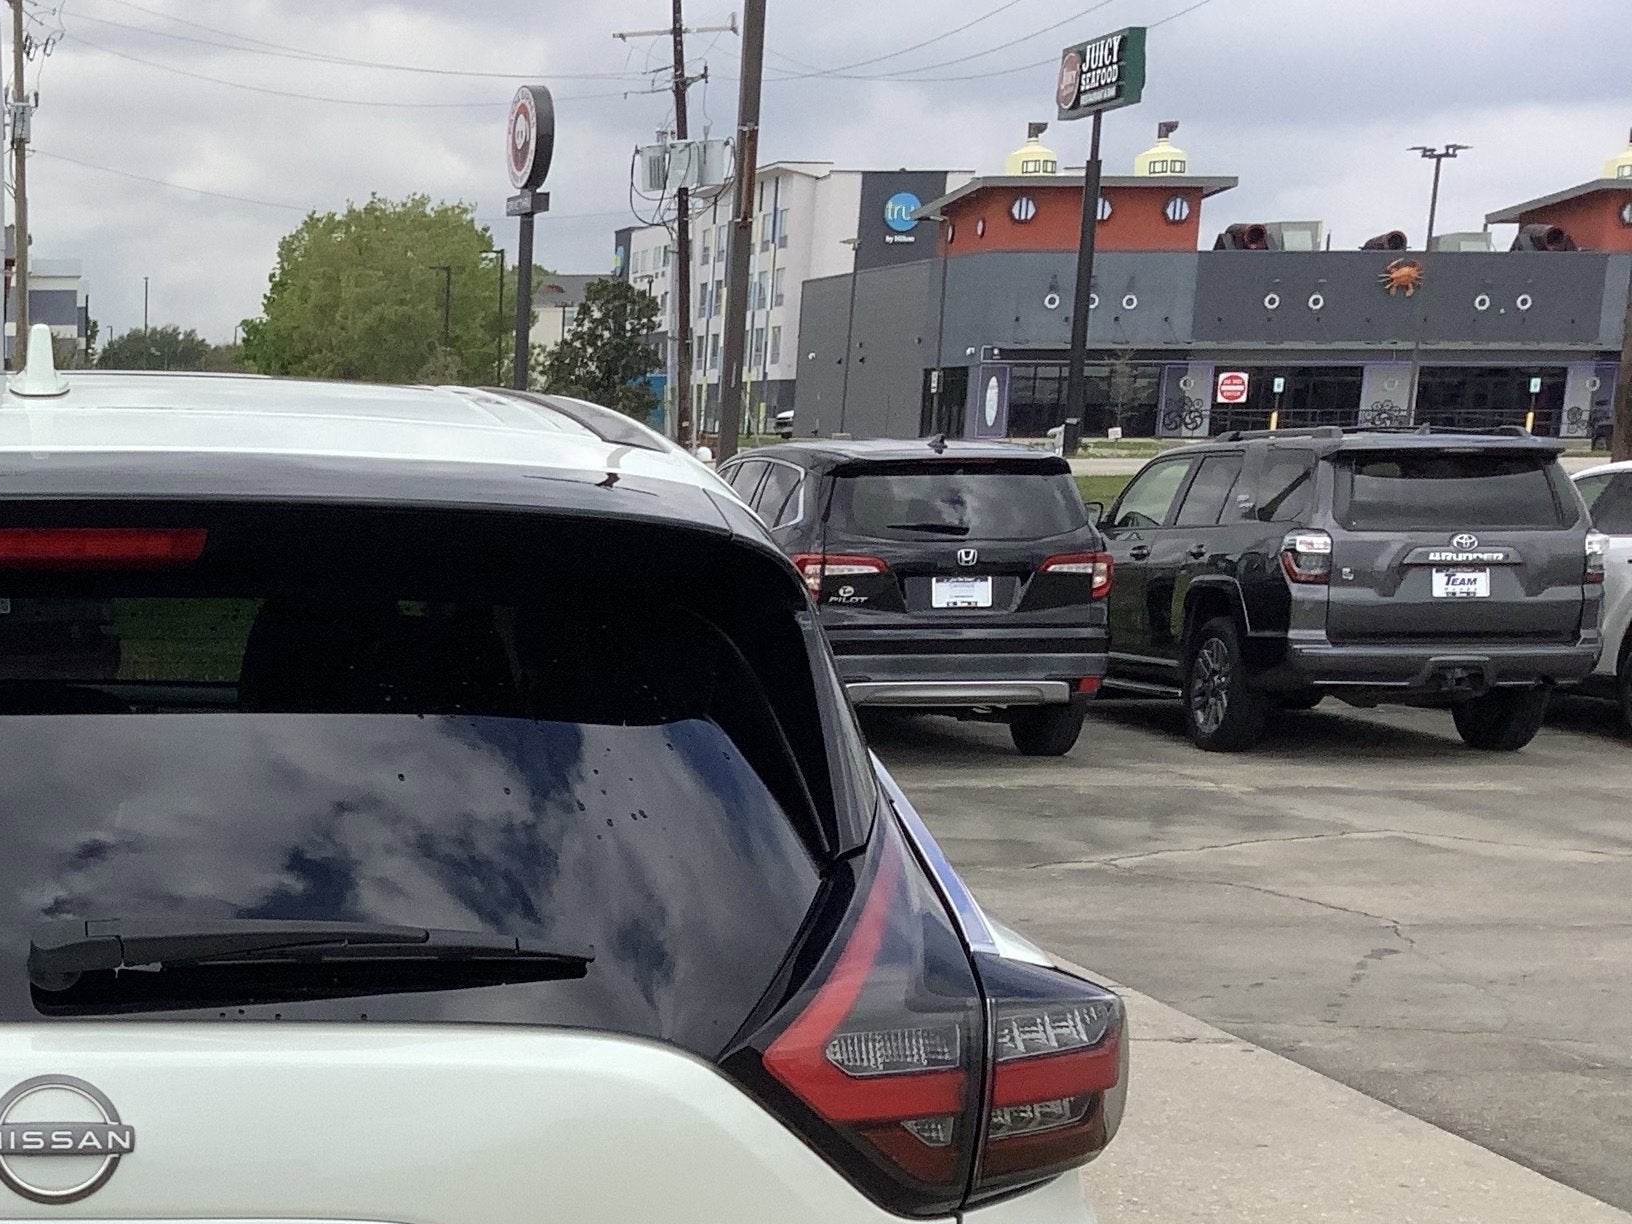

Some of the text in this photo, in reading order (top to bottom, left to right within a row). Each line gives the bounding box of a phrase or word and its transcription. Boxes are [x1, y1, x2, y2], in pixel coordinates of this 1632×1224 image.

[1081, 35, 1122, 72] JUICY
[1080, 64, 1118, 92] SEAFOOD
[1444, 573, 1478, 586] TEAM
